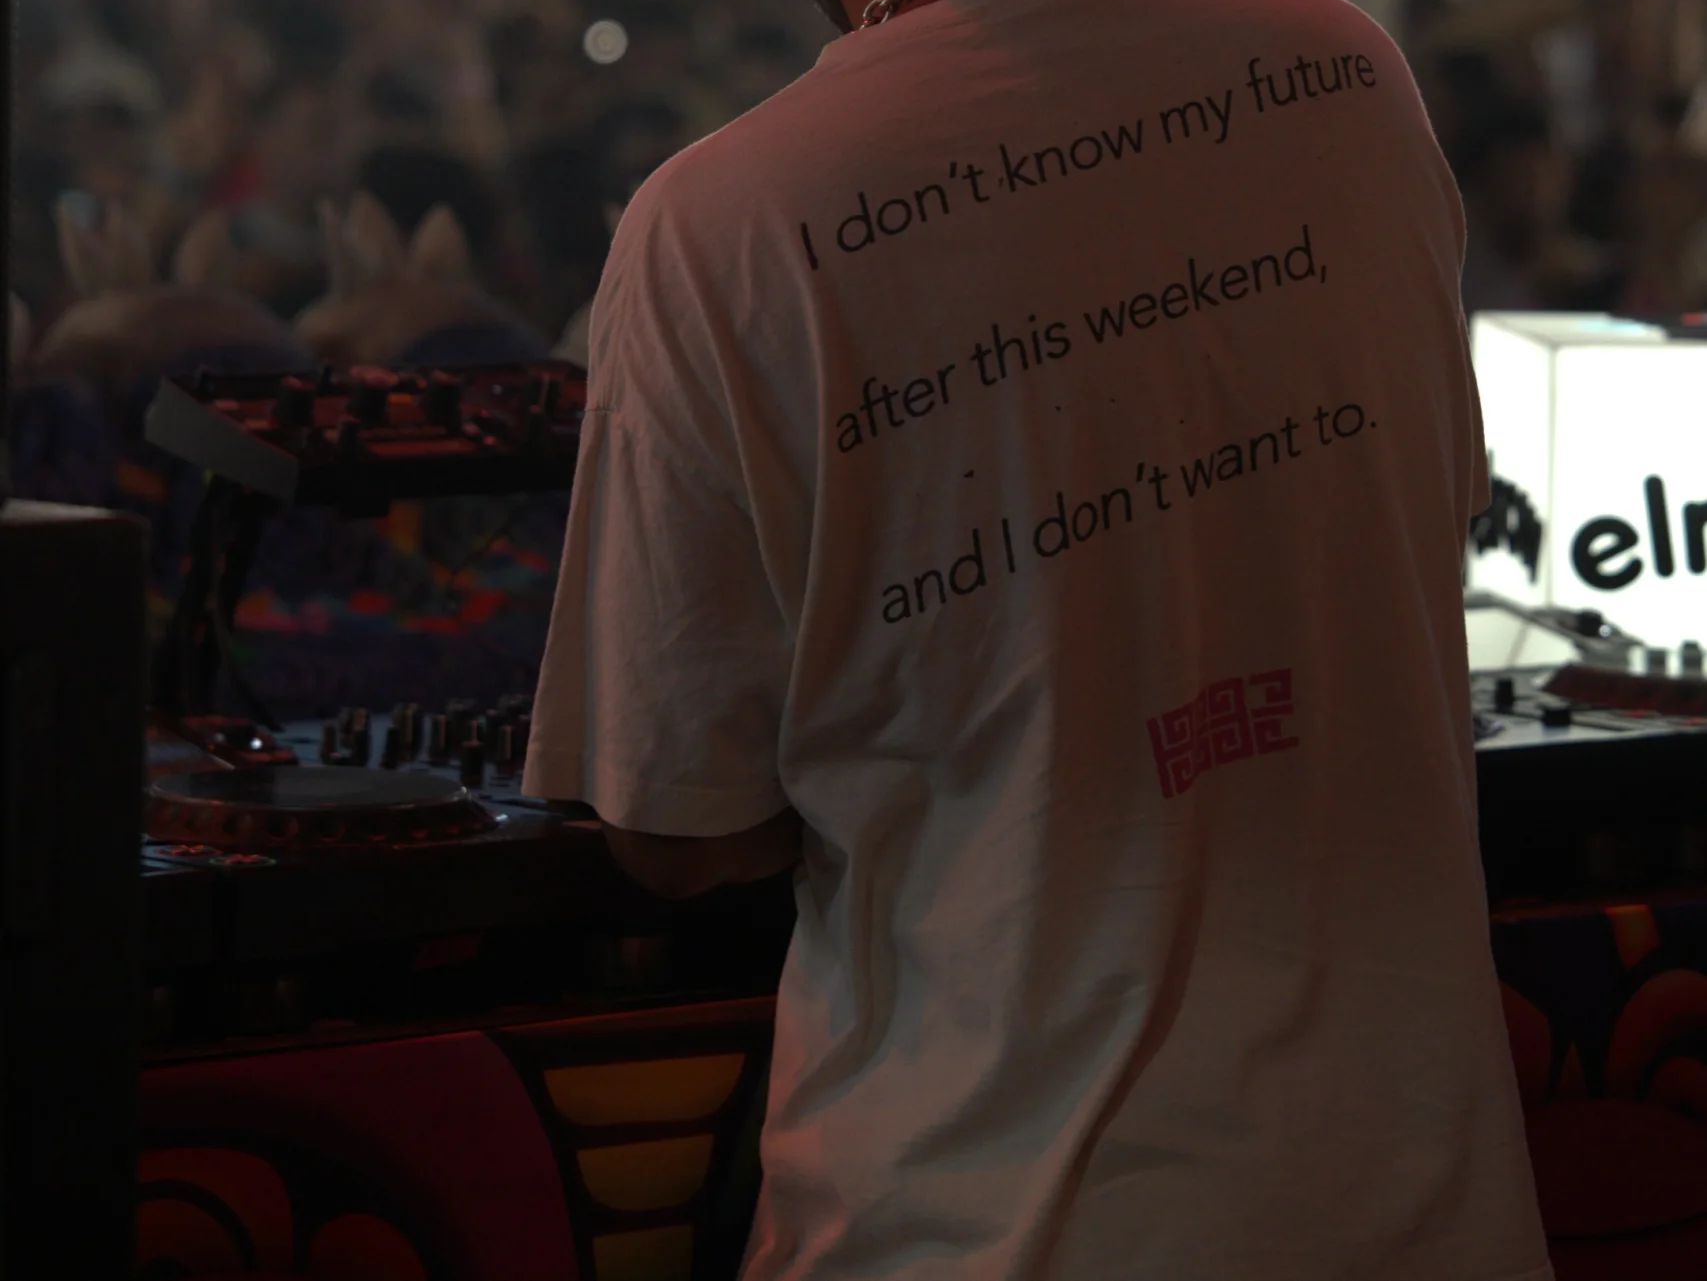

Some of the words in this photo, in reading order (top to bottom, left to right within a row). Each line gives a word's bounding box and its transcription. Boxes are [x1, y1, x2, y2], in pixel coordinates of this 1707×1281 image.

[800, 222, 818, 270] I
[836, 161, 990, 253] don't
[1000, 119, 1143, 192] know
[1159, 90, 1233, 144] my
[1247, 52, 1377, 113] future
[836, 364, 955, 453] after
[970, 315, 1071, 386] this
[1084, 224, 1328, 344] weekend,
[881, 529, 986, 623] and
[1001, 518, 1015, 573] I
[1033, 462, 1171, 558] don't
[1181, 417, 1301, 498] want
[1313, 402, 1377, 445] to.
